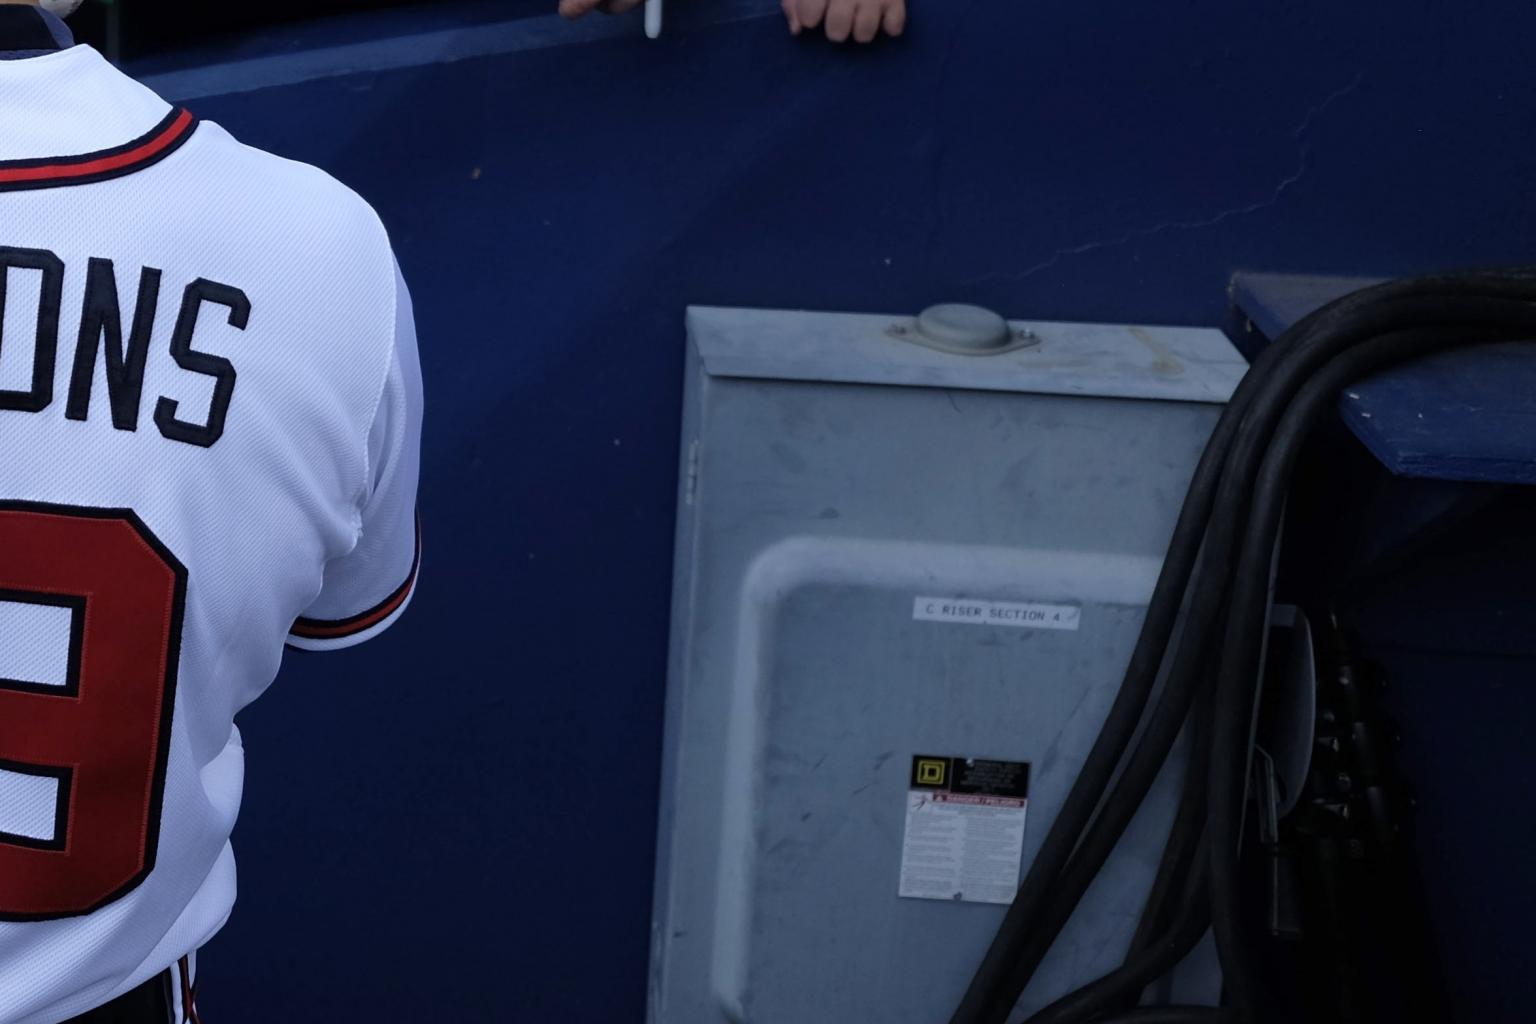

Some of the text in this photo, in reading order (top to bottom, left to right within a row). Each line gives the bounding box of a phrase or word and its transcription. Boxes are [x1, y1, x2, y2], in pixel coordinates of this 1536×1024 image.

[925, 604, 1061, 622] C RISER SECTION 4
